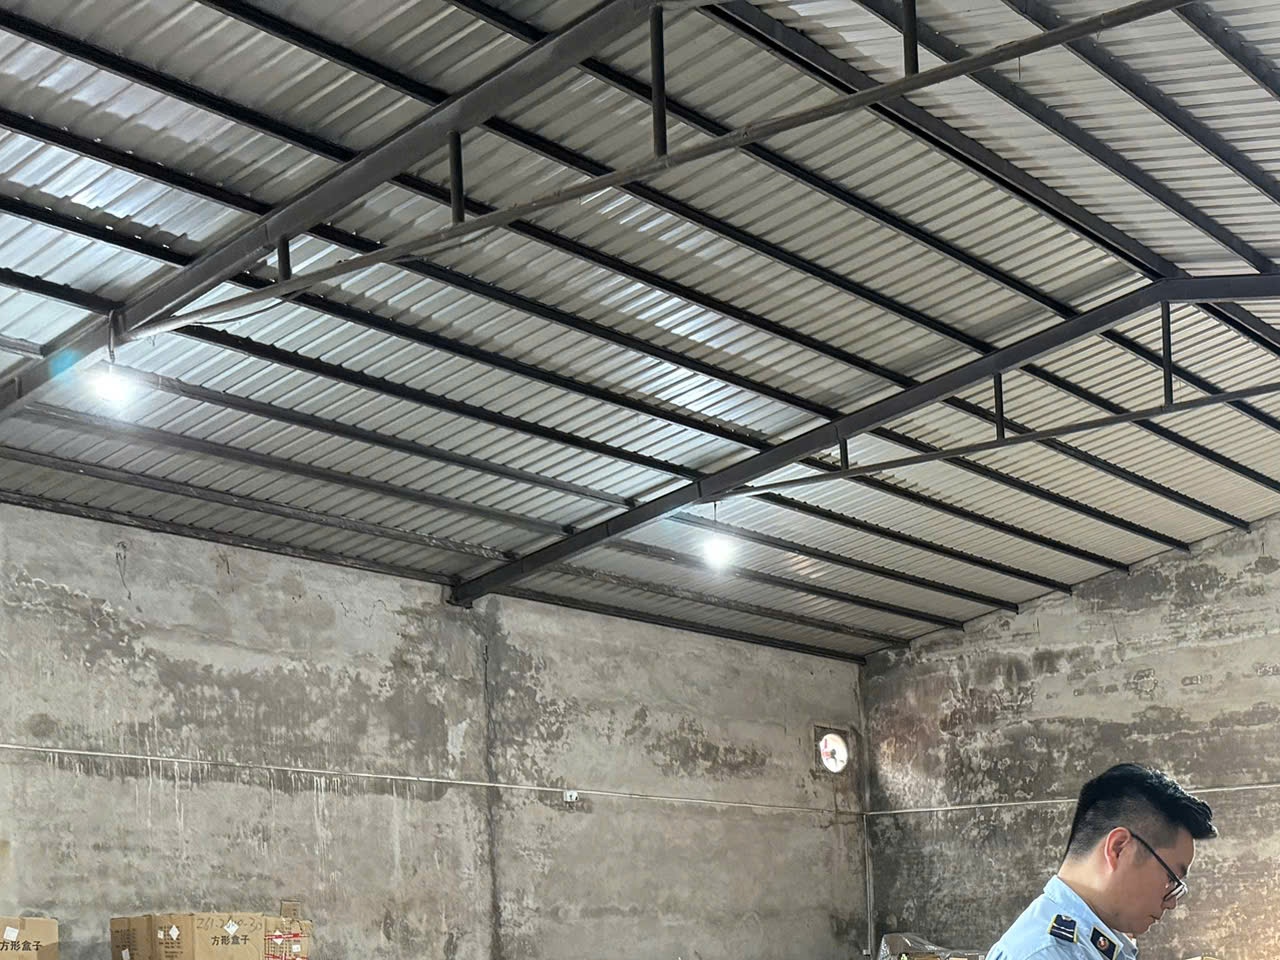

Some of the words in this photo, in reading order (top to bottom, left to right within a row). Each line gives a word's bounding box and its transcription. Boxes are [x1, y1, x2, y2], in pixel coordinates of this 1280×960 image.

[211, 934, 251, 946] 方形盒子
[0, 941, 42, 951] 方形盒子
